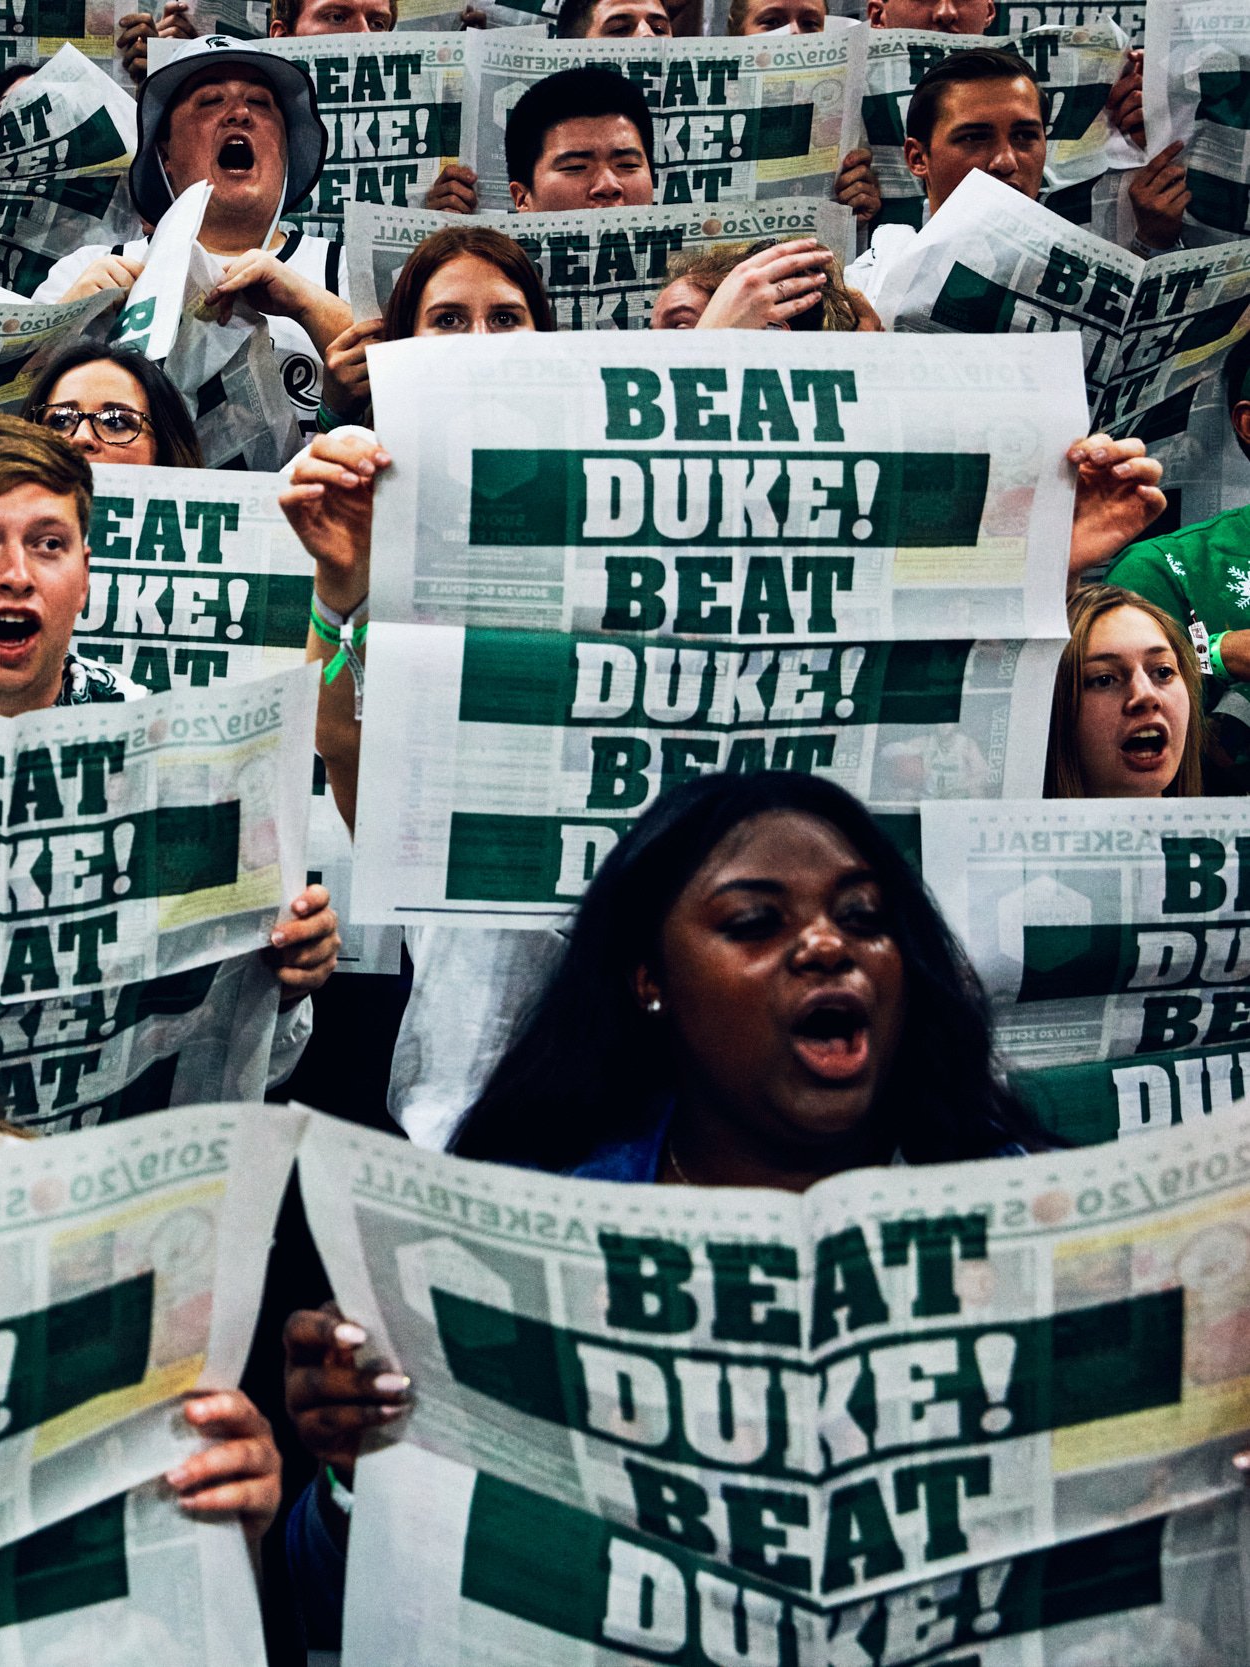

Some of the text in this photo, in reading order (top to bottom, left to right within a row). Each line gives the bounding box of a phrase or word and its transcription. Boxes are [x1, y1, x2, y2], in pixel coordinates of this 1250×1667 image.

[294, 54, 421, 105] EAT
[629, 60, 739, 107] EAT
[325, 108, 430, 160] UKE!
[654, 114, 748, 164] KE!
[1036, 246, 1210, 333] BEAT
[600, 367, 858, 443] BEAT
[88, 496, 240, 564] EAT
[582, 458, 881, 541] DUKE!
[73, 572, 249, 640] UKE!
[600, 556, 855, 636] BEAT
[570, 643, 866, 725] DUKE!
[598, 1214, 988, 1351] BEAT
[576, 1332, 1018, 1476] DUKE!
[622, 1455, 992, 1596] BEAT
